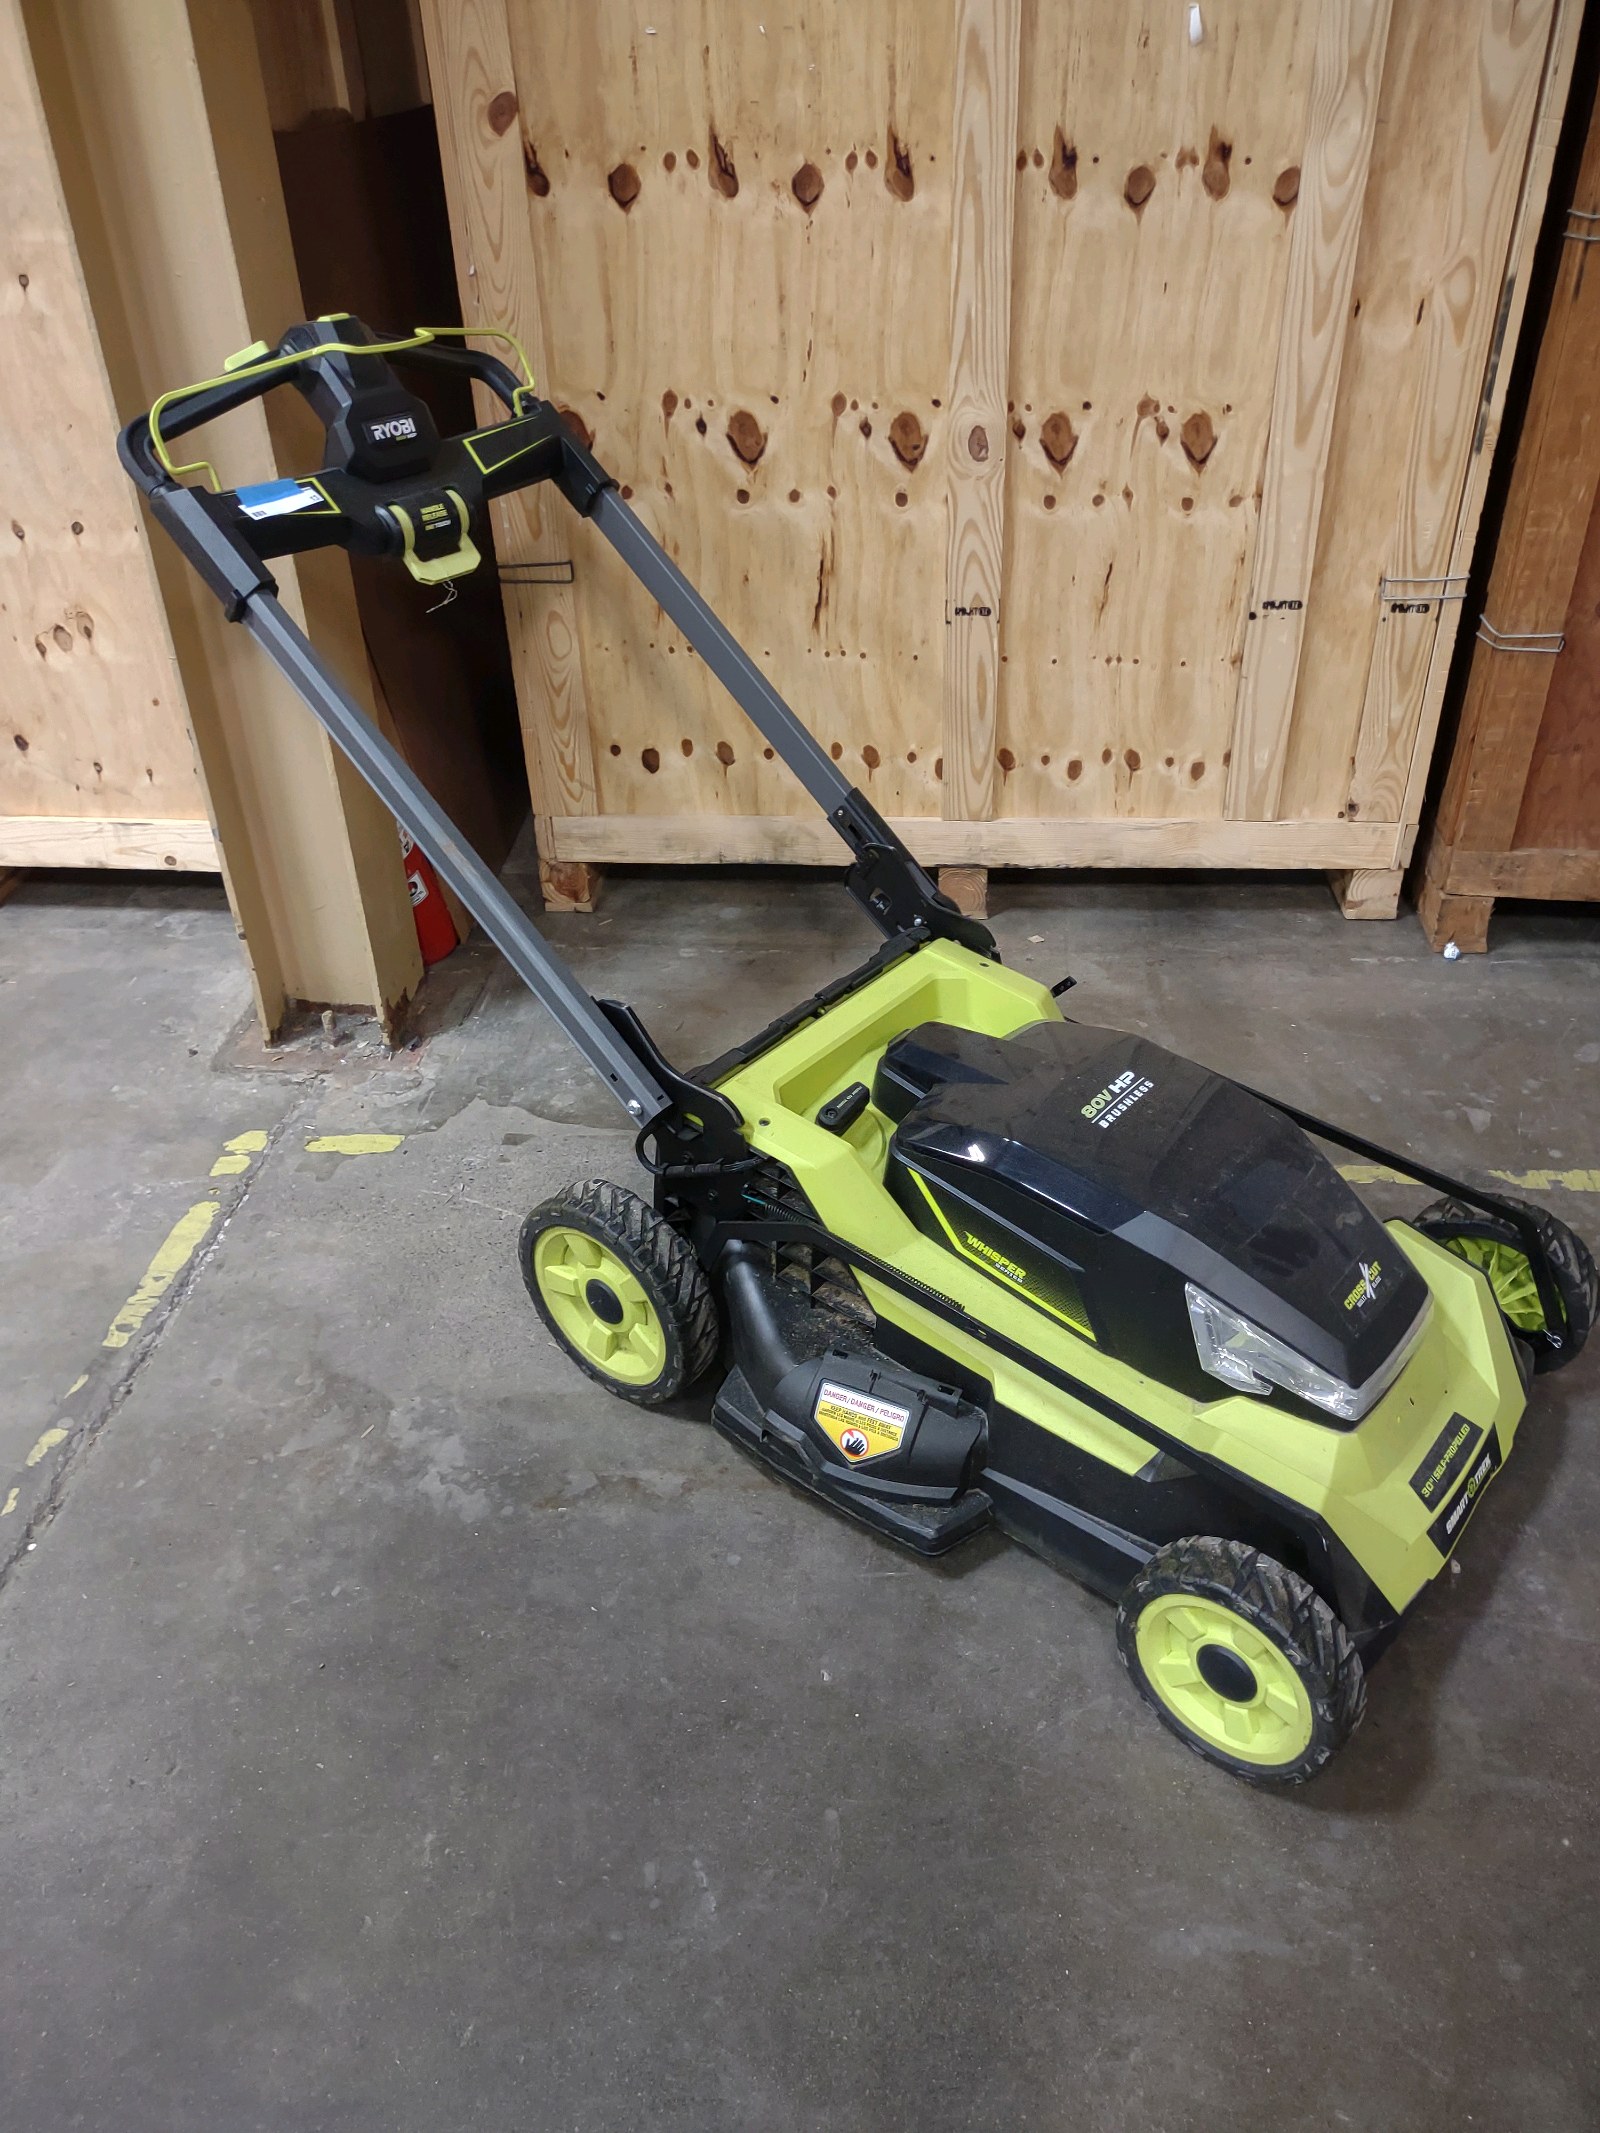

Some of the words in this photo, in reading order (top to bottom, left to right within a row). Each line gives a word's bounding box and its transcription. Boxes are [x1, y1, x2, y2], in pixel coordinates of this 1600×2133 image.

[370, 417, 416, 440] RYOBI
[1081, 1088, 1112, 1118] 80V
[1108, 1071, 1135, 1093] HP
[1098, 1080, 1154, 1128] BRUSHLESS
[964, 1230, 1026, 1279] WHISPER
[1368, 1261, 1381, 1281] CUT
[823, 1389, 847, 1404] DANGER
[850, 1398, 875, 1413] DANGER
